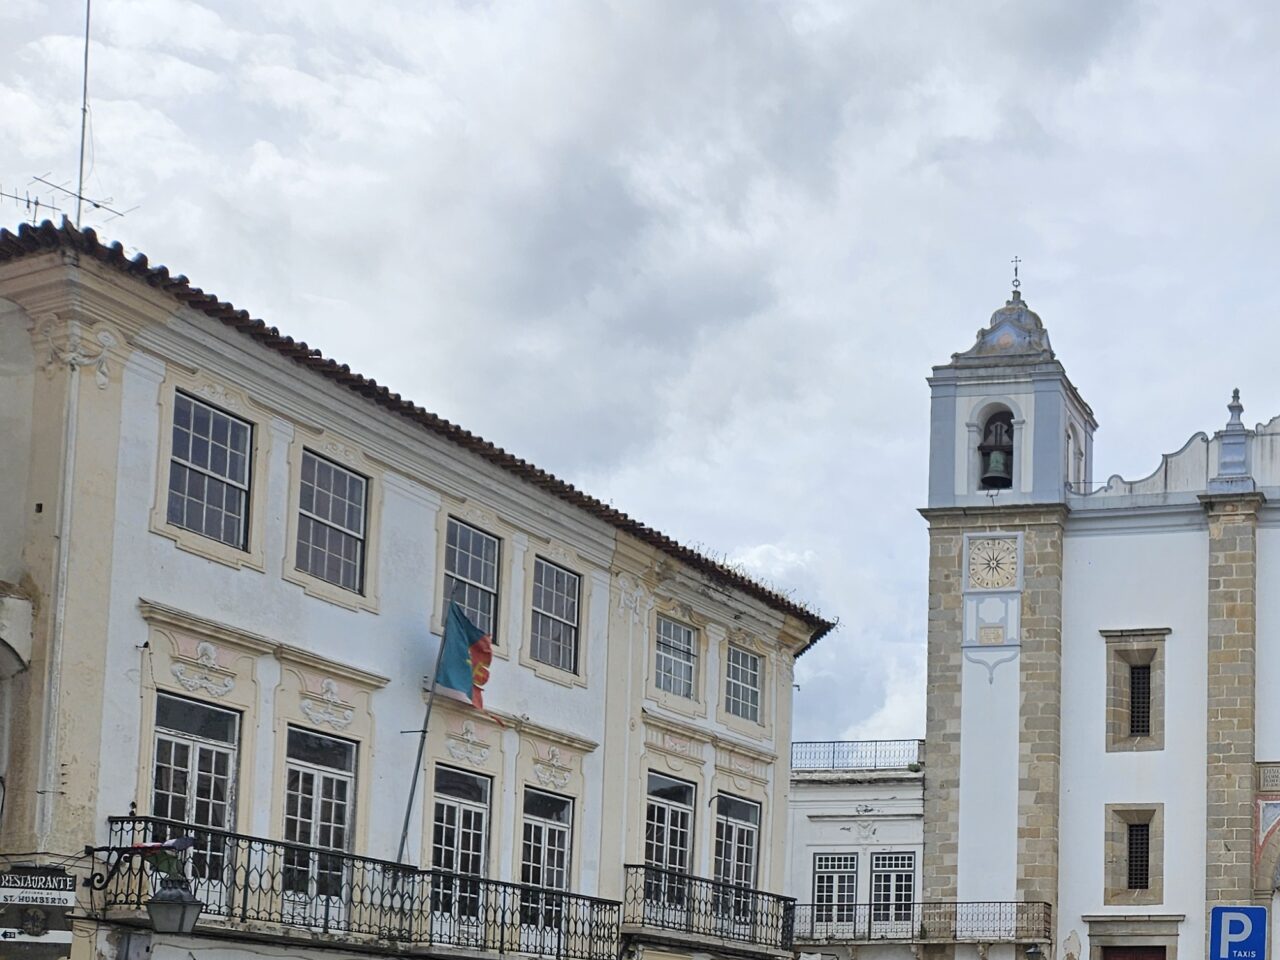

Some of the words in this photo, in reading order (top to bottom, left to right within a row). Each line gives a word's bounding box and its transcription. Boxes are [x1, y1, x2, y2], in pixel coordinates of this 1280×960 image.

[1, 874, 73, 890] RESTAURANTE
[18, 896, 68, 905] HUMBERTO
[1220, 911, 1253, 959] P
[1232, 950, 1257, 958] TAXIS
